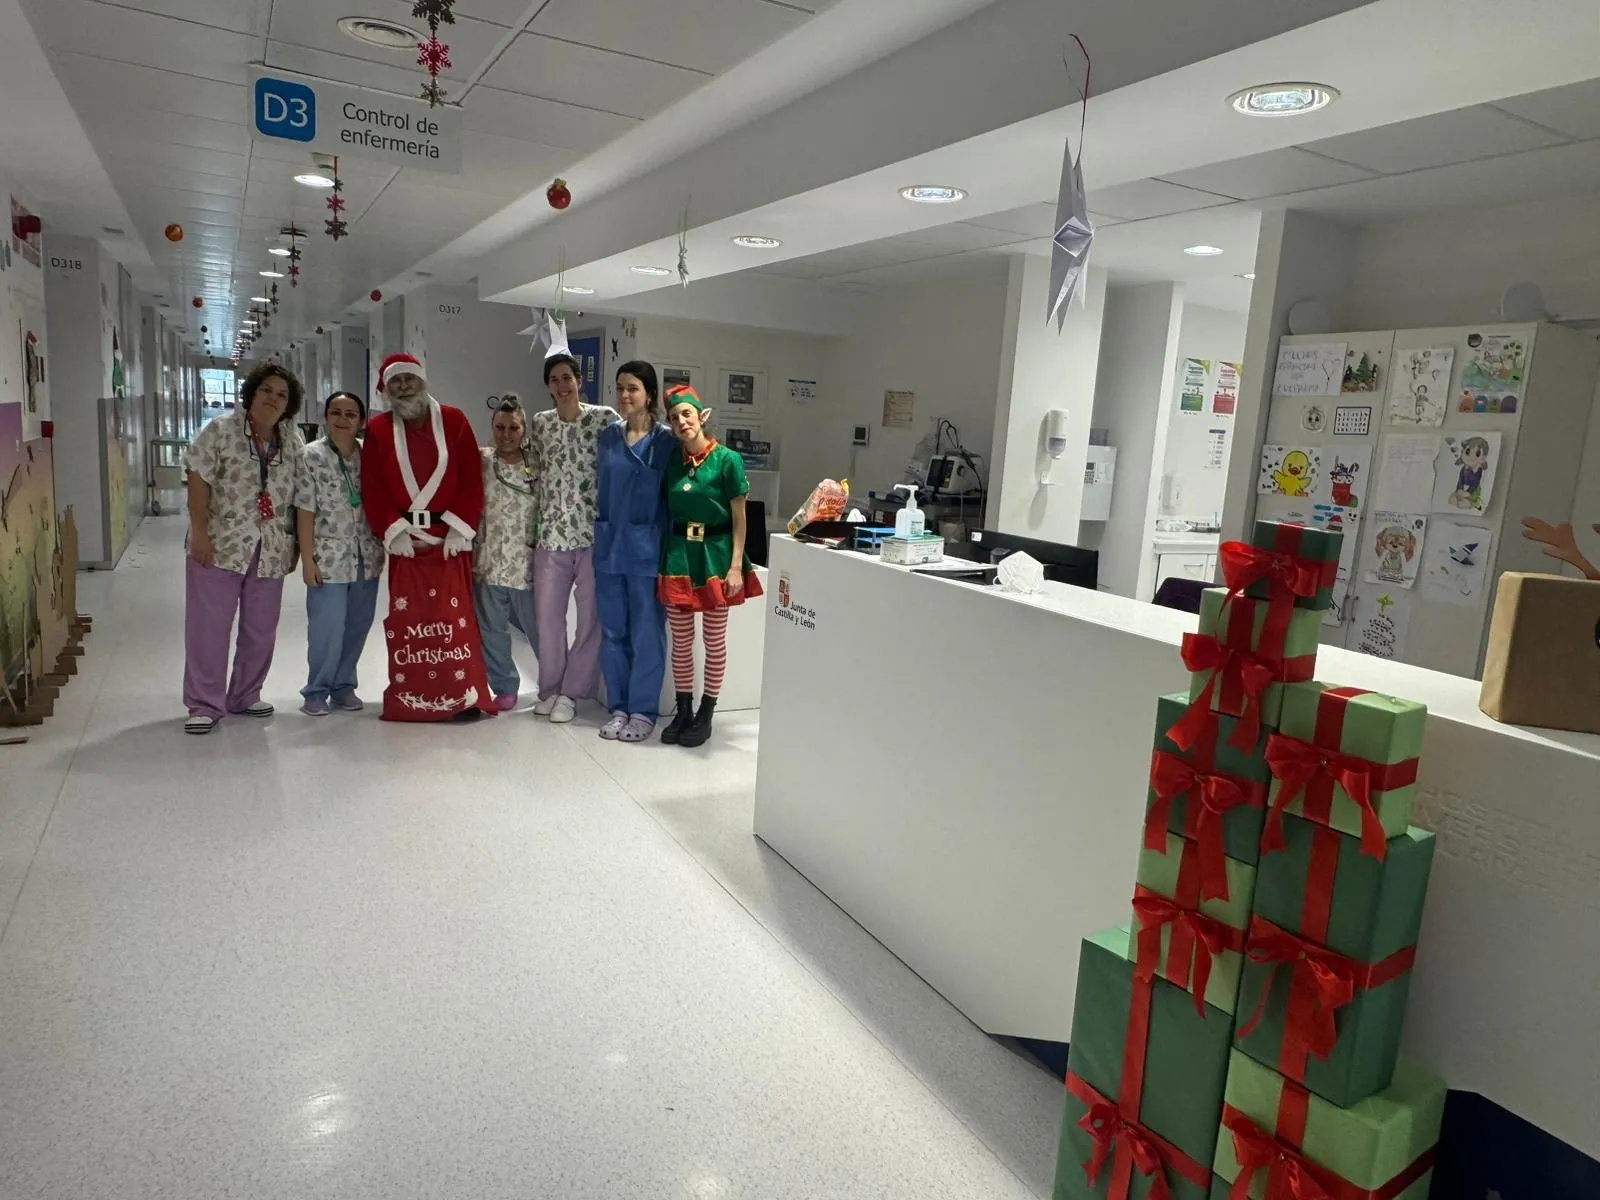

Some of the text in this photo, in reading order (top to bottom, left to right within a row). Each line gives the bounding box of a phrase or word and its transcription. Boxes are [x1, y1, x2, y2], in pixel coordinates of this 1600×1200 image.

[263, 92, 309, 128] D3
[343, 102, 439, 136] Control de
[341, 128, 440, 159] enfermería
[774, 605, 816, 631] Castilla y León
[790, 601, 816, 620] Junta de
[404, 621, 453, 643] Merry
[394, 643, 471, 665] Christmas
